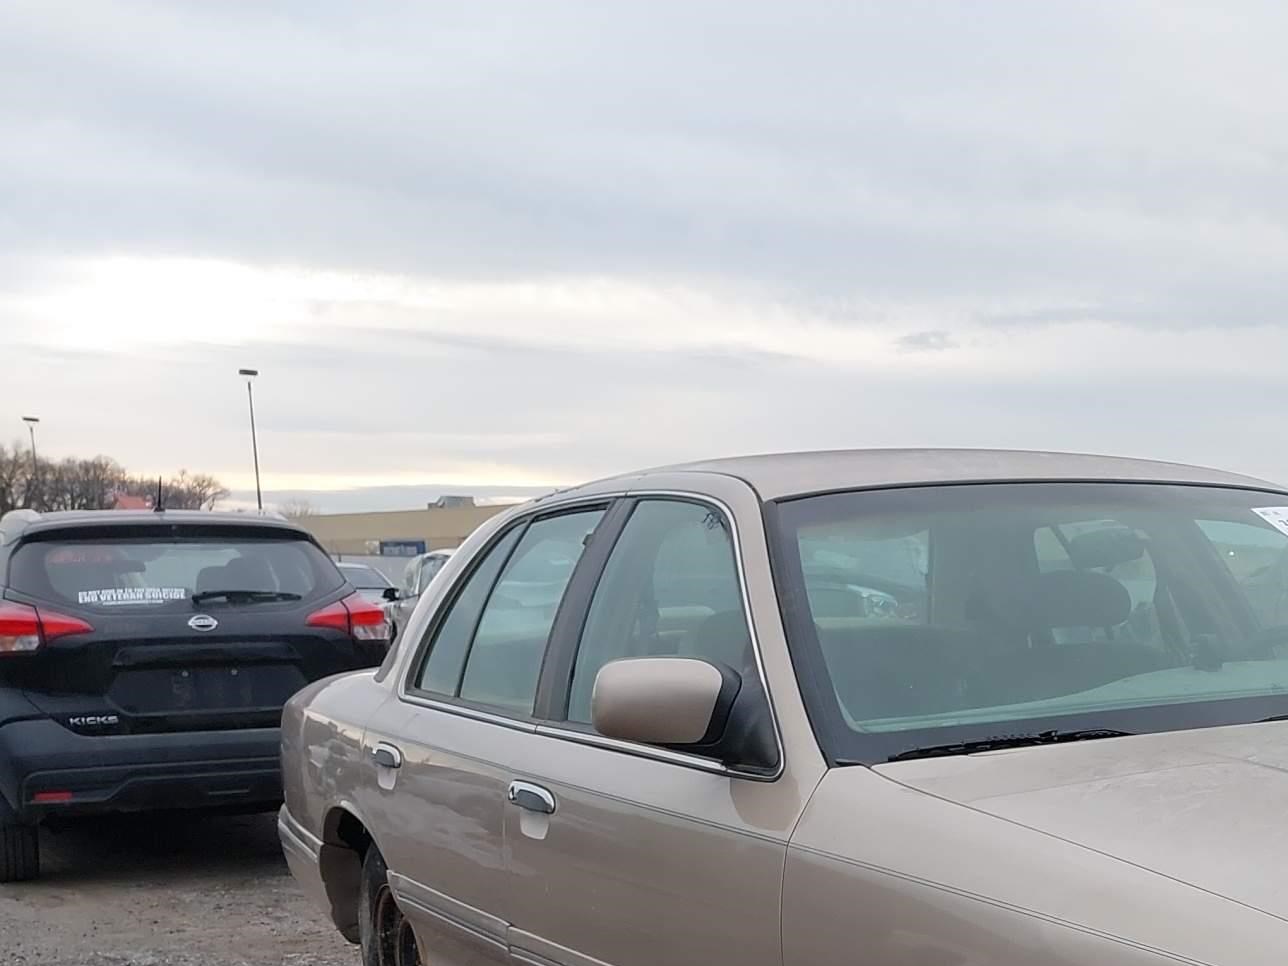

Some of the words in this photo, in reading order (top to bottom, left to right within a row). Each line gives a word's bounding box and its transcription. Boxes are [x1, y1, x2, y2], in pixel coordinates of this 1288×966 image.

[78, 594, 98, 604] END
[99, 592, 144, 601] VETERAN
[145, 591, 186, 600] SUICIDE
[69, 715, 119, 726] KICKS
